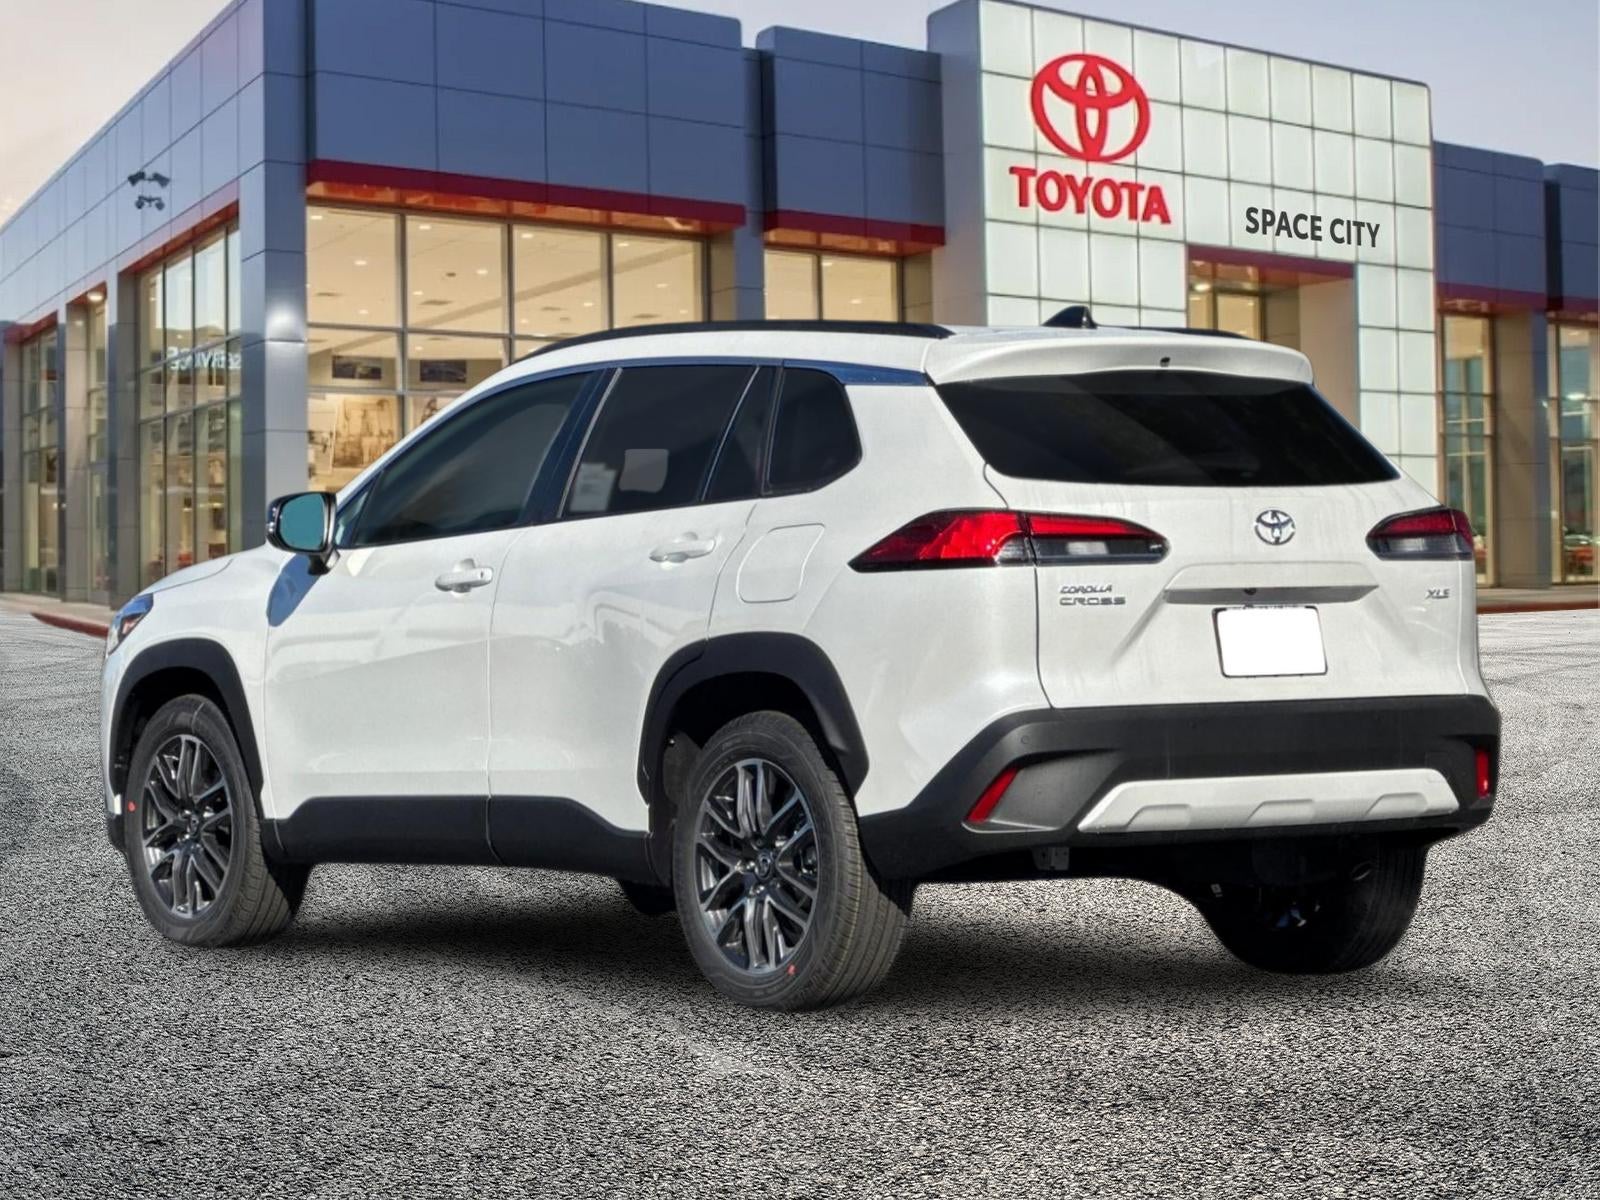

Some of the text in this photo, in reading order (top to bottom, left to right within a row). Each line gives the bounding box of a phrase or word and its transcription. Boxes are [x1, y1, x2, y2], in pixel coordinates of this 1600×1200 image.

[1009, 166, 1171, 224] TOYOTA
[1245, 206, 1381, 248] SPACE CITY
[1060, 585, 1112, 594] COROLLA
[1425, 589, 1450, 600] XLE
[1059, 597, 1126, 606] CROSS
